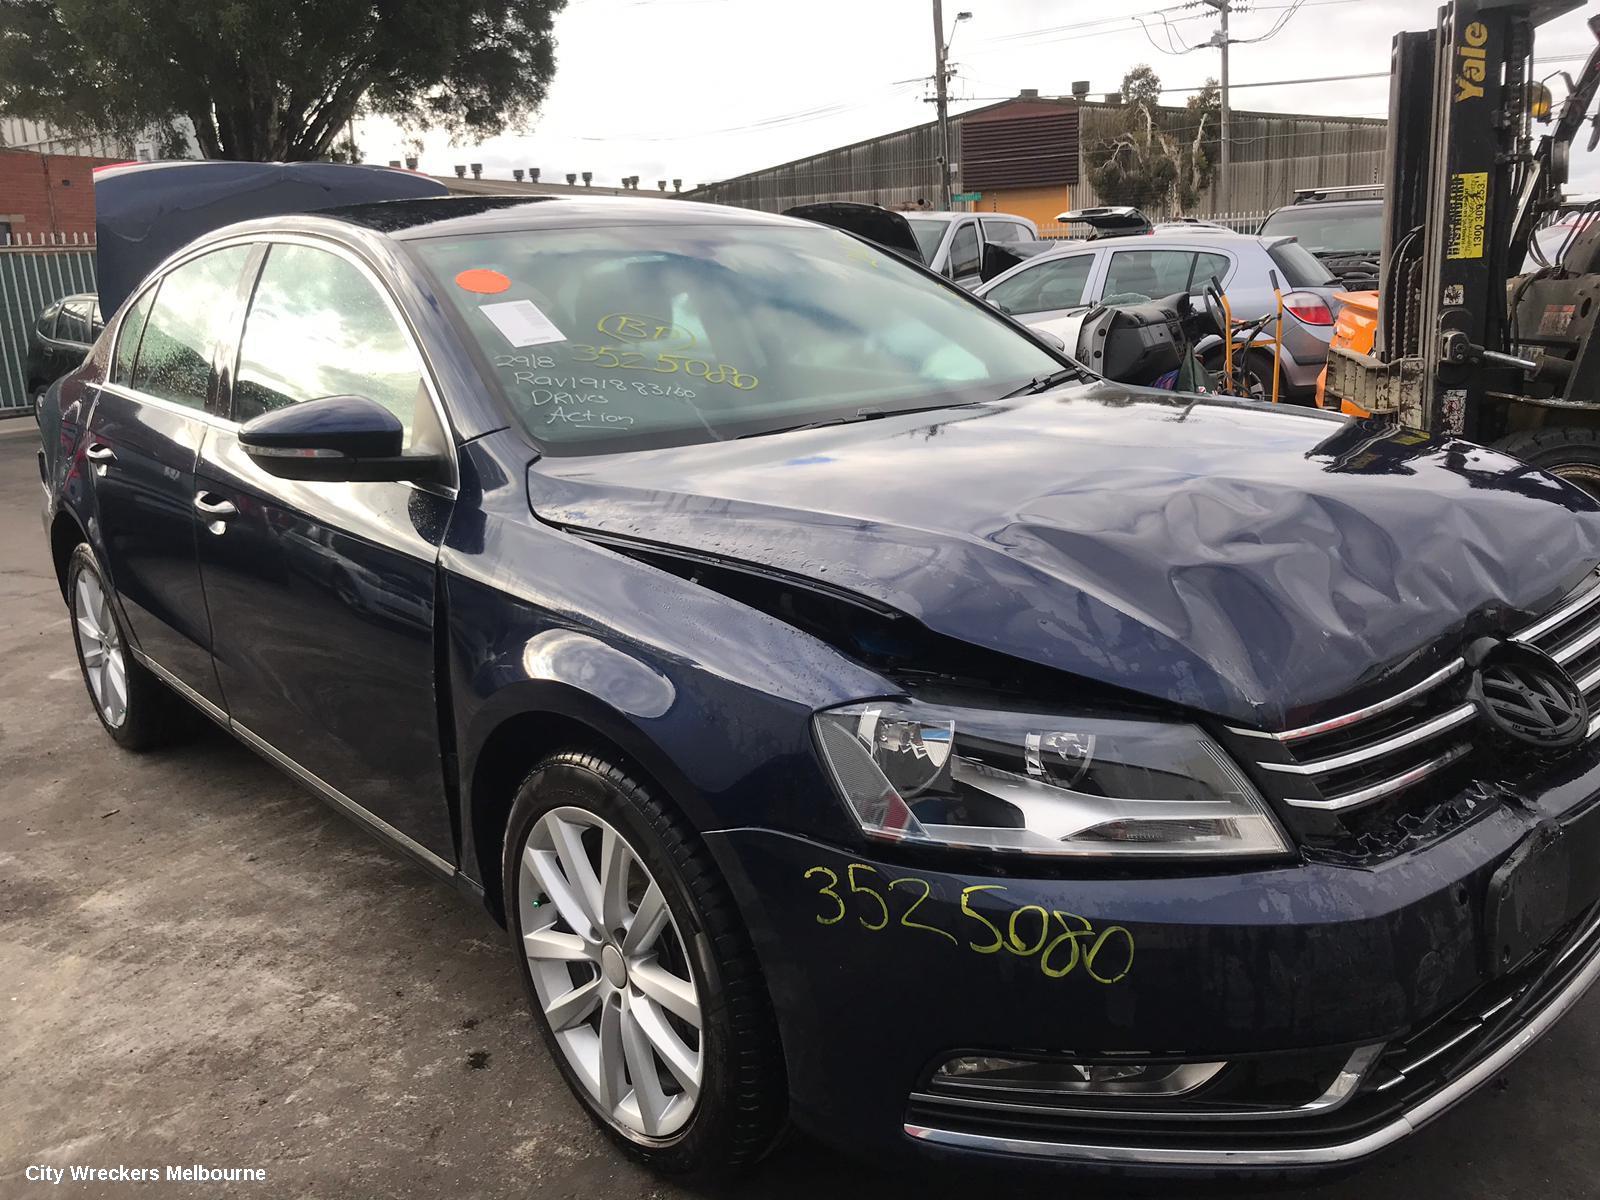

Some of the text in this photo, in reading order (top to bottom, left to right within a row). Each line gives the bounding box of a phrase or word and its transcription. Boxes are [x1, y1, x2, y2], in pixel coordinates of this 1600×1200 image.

[1455, 21, 1488, 103] Yale
[1473, 183, 1486, 247] 1300 309 253
